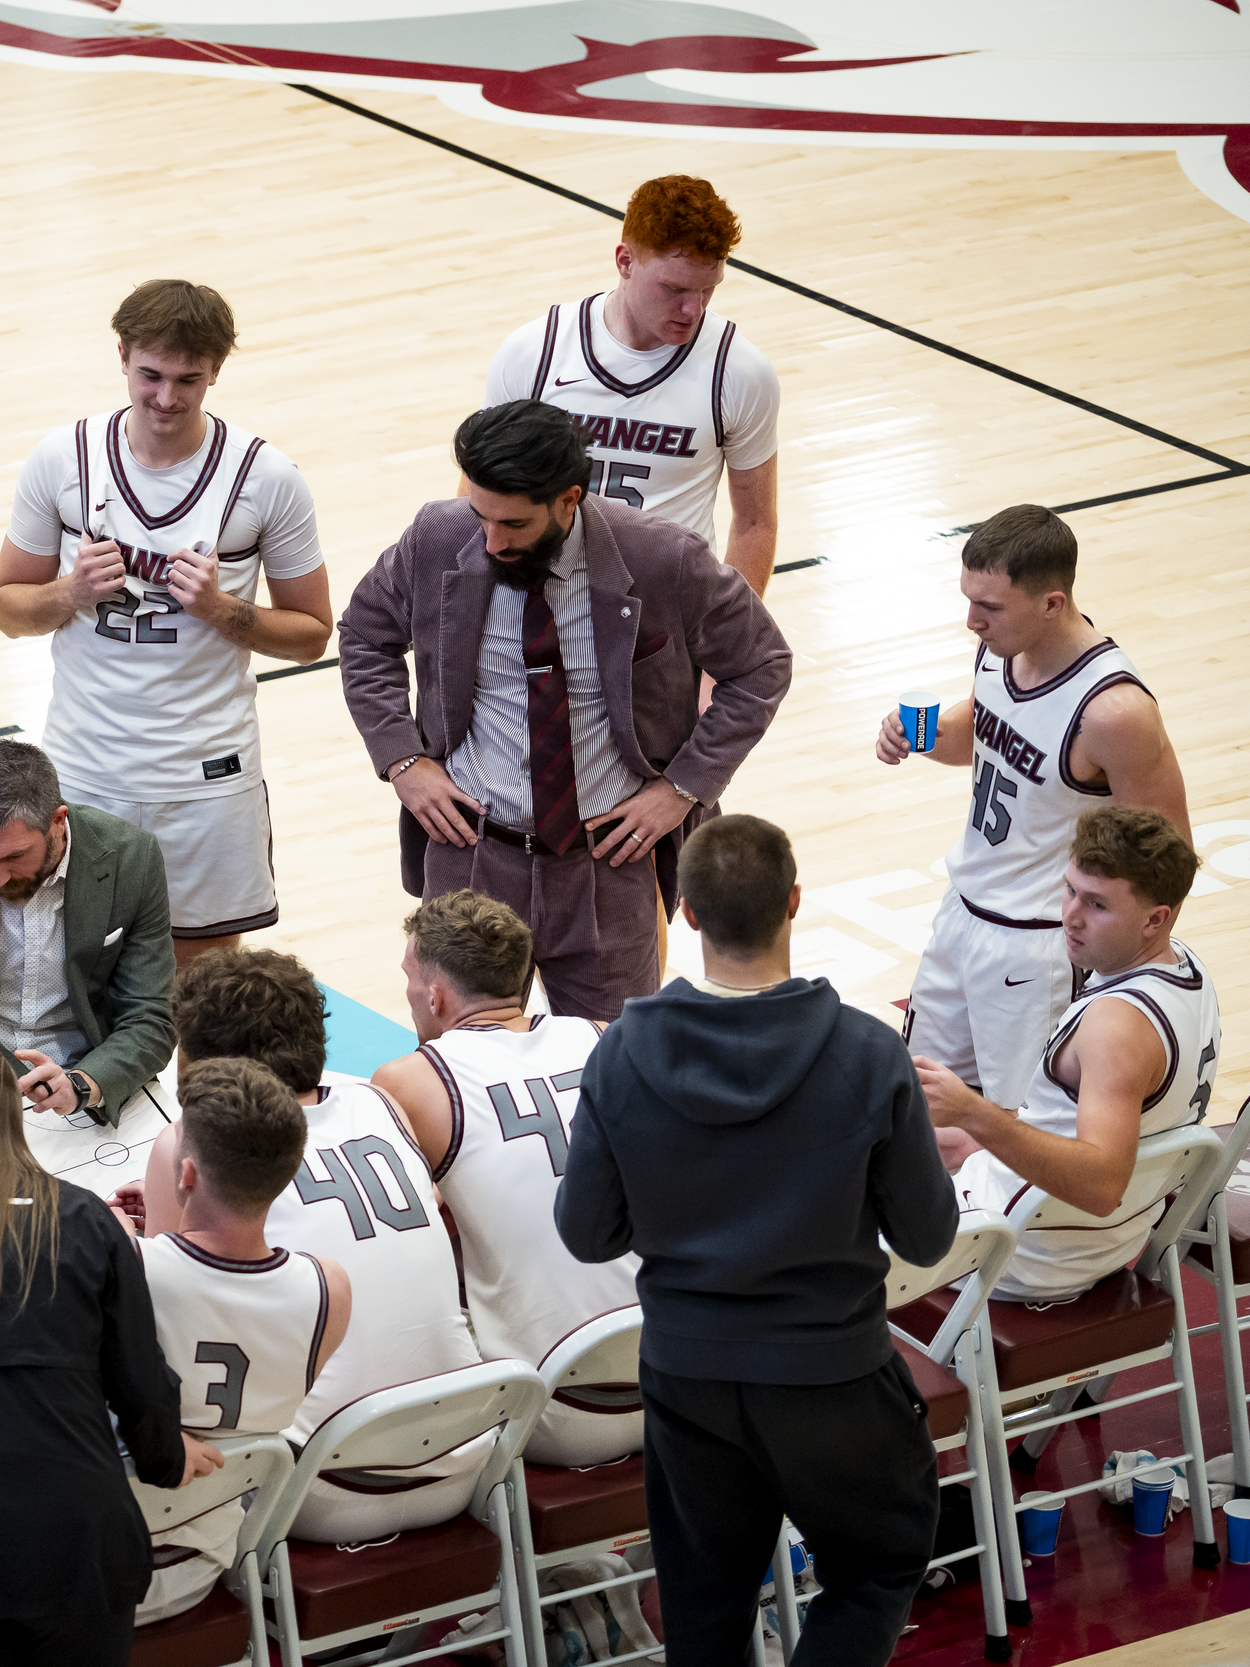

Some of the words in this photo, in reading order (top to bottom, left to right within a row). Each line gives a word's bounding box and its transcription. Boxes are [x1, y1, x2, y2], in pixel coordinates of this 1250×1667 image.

[568, 412, 699, 459] VANGEL
[95, 587, 183, 643] 22
[916, 708, 927, 750] POWERADE
[486, 1068, 584, 1178] 4
[291, 1134, 430, 1242] 40
[180, 1341, 250, 1431] 3
